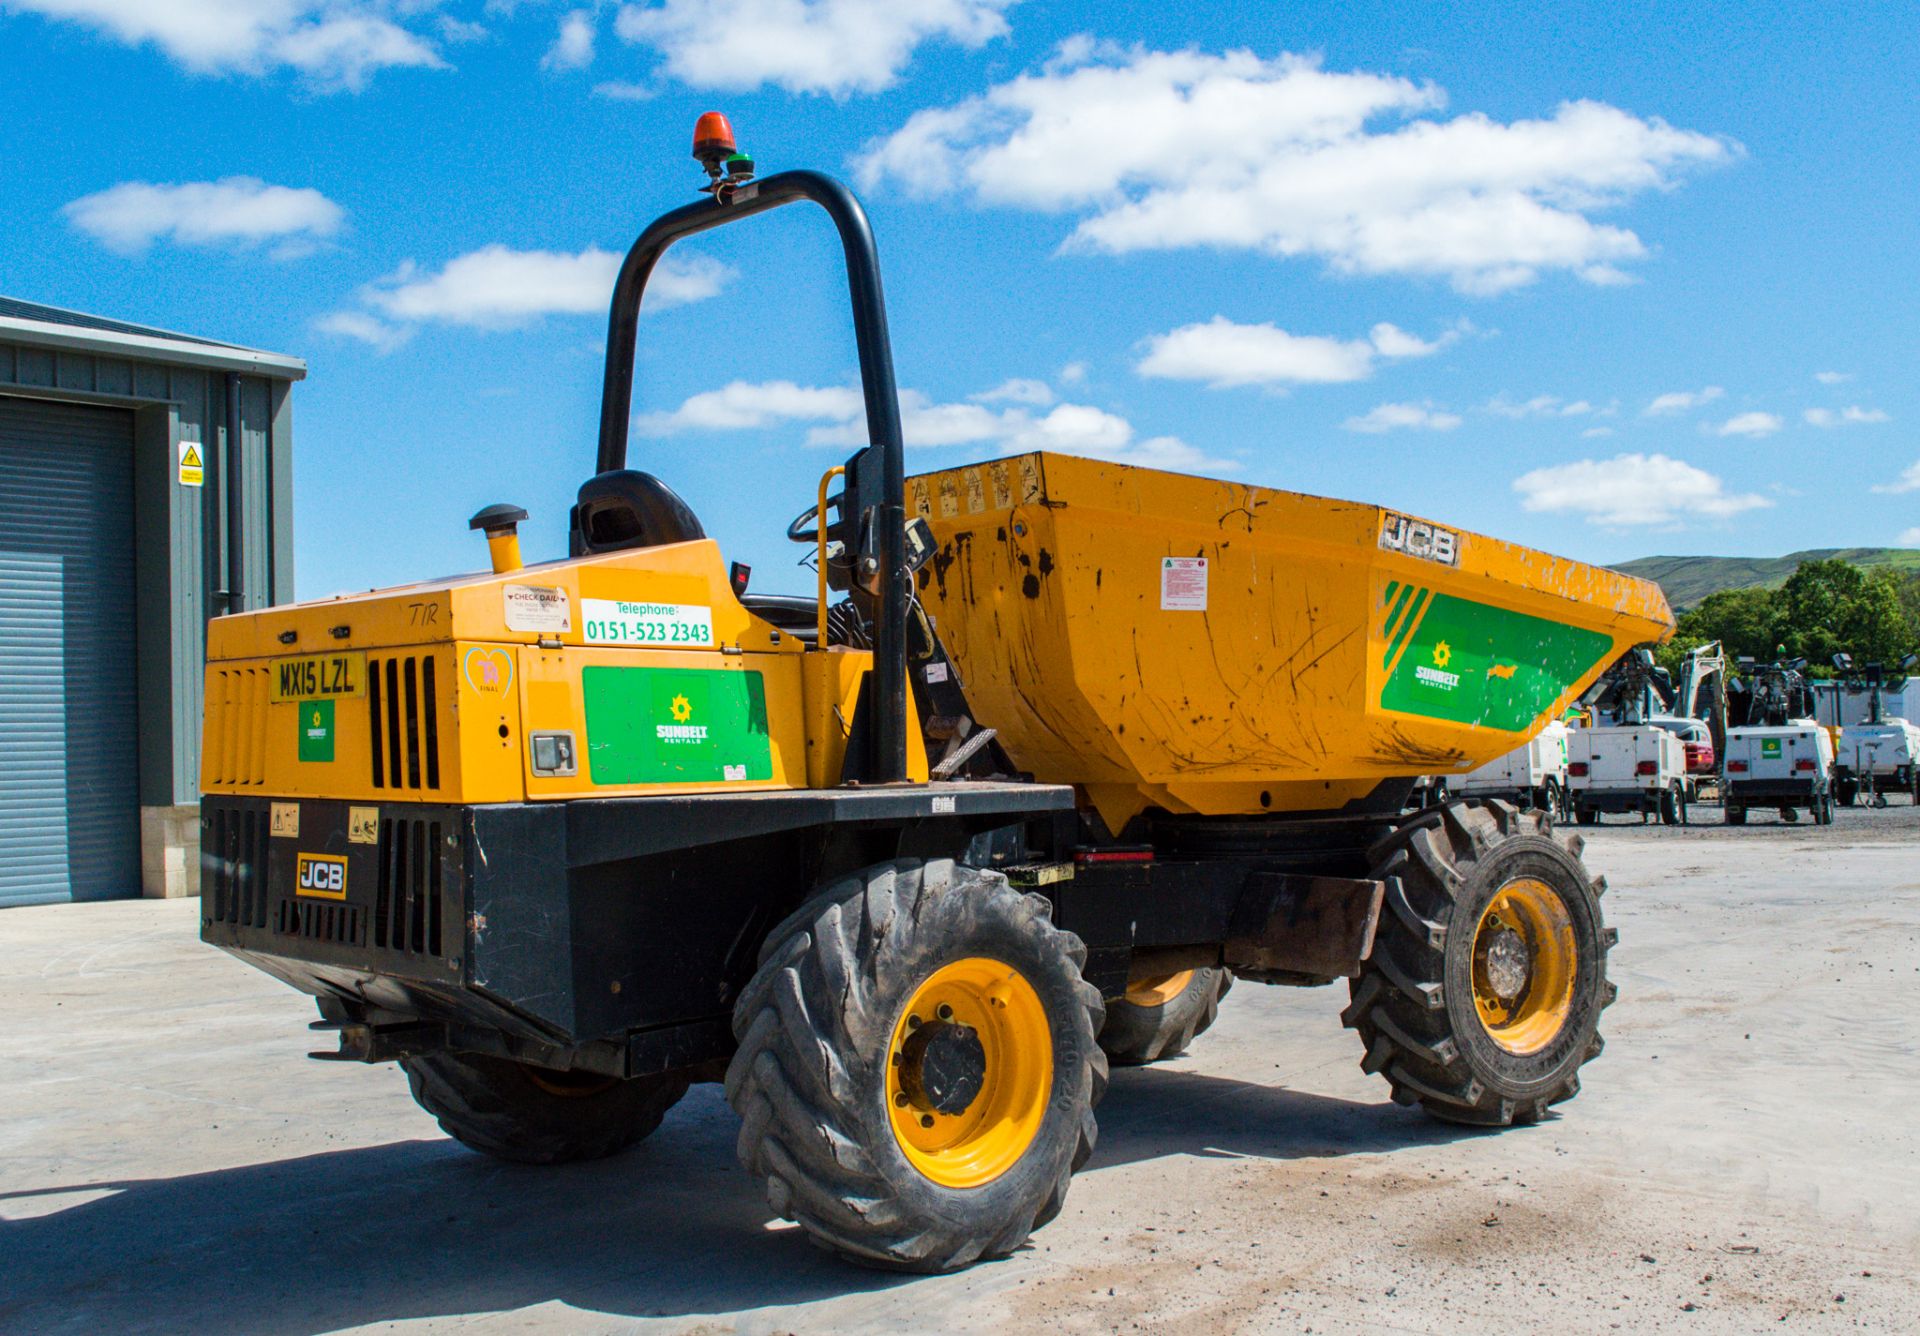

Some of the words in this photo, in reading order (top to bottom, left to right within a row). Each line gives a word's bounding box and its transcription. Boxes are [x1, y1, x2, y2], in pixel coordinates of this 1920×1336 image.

[1384, 518, 1455, 565] JCB
[514, 593, 539, 601] CHECK
[587, 620, 666, 641] 0151-523
[670, 622, 709, 643] 2343
[280, 661, 316, 697] MX15
[321, 658, 354, 693] LZL
[1416, 665, 1460, 687] SUNBELT
[1420, 679, 1452, 691] RENTALS
[656, 725, 708, 738] SUNBELT
[301, 862, 344, 891] JCB
